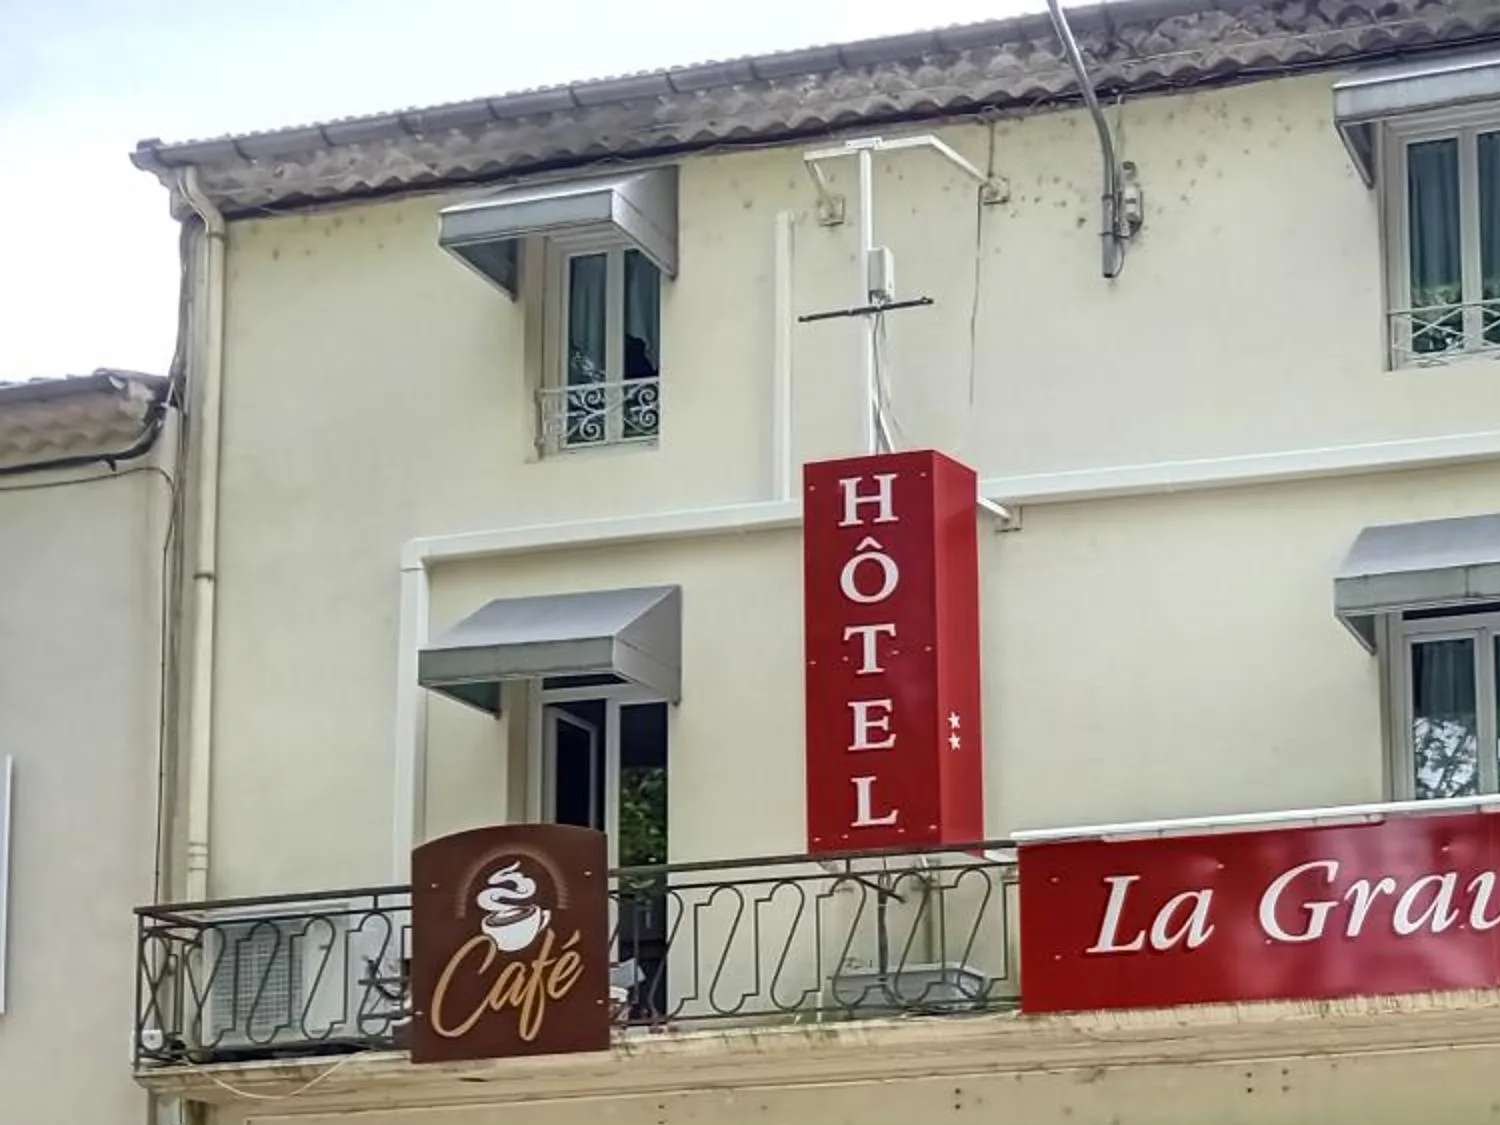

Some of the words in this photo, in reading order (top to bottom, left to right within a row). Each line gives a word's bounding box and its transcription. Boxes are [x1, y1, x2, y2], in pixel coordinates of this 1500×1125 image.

[837, 472, 900, 829] HÔTEL
[1086, 873, 1215, 955] La
[430, 928, 585, 1042] Café
